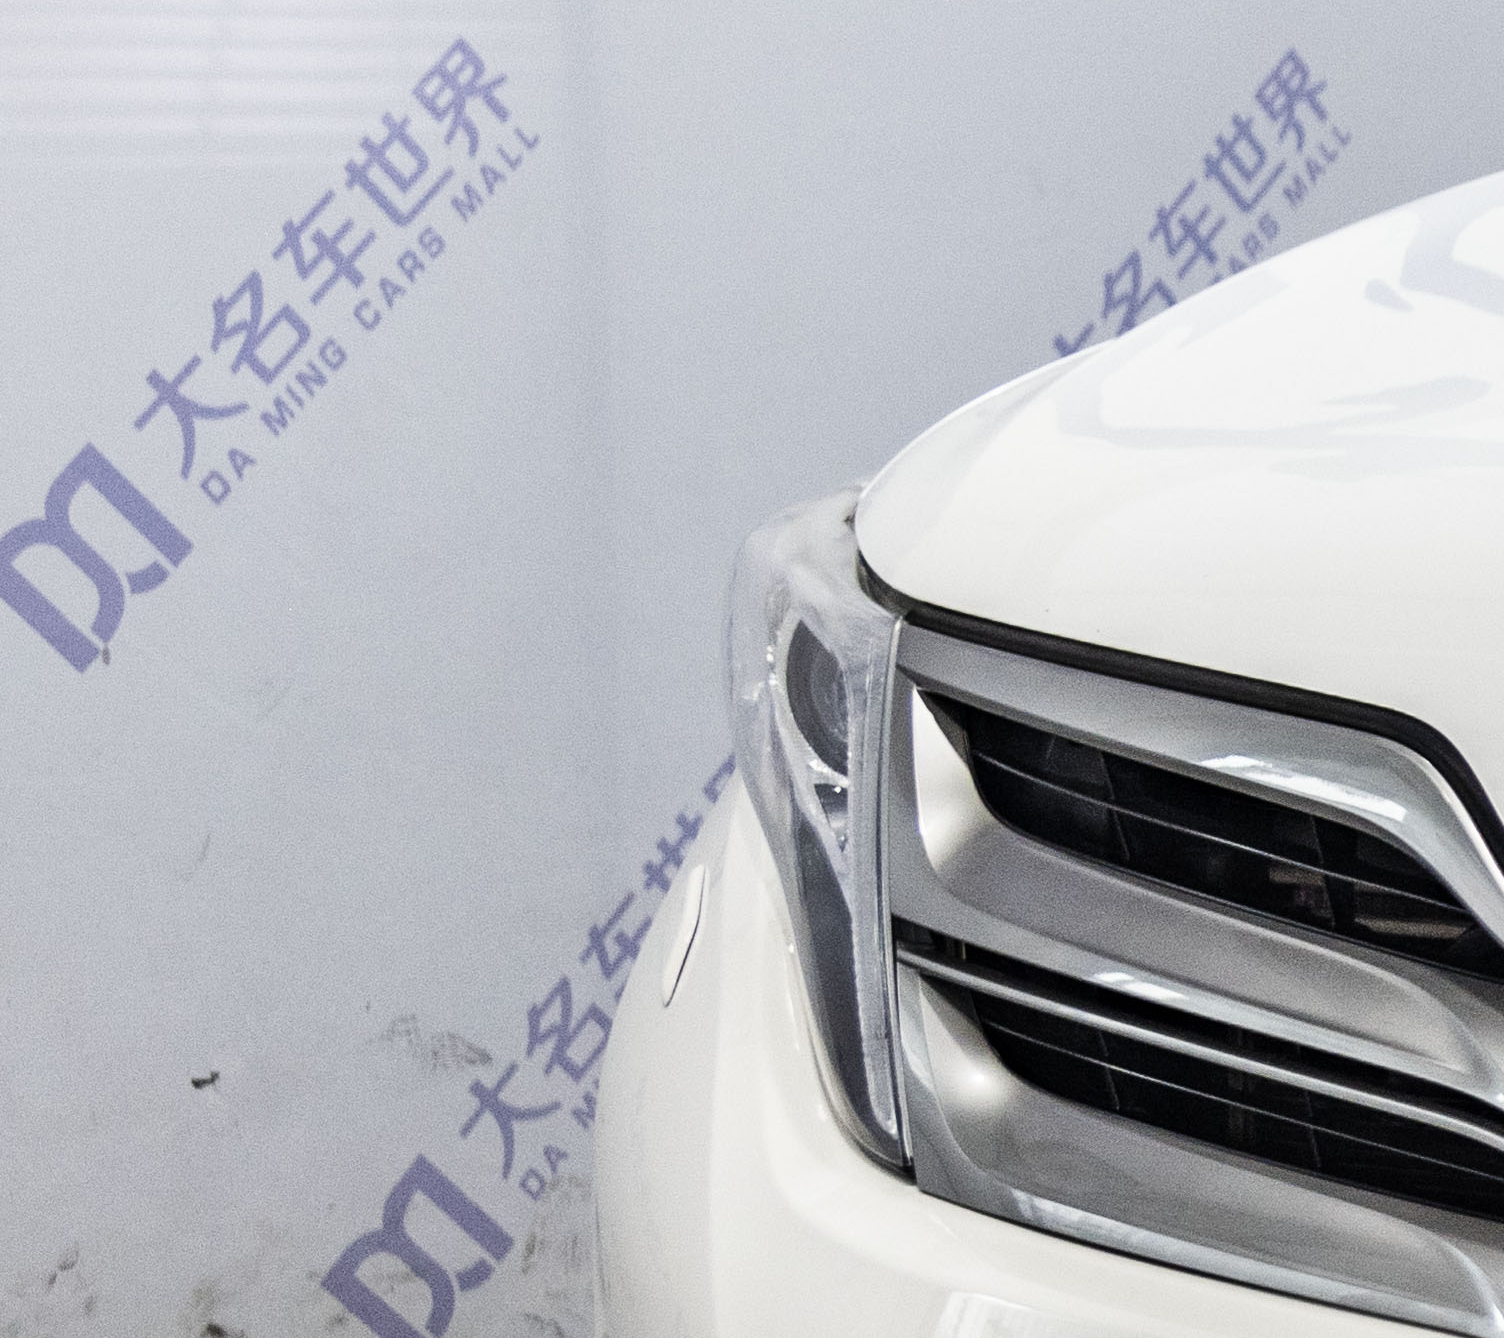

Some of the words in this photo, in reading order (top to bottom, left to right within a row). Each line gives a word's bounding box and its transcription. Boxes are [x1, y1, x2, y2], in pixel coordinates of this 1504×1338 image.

[134, 36, 511, 481] 大名车世界
[199, 445, 257, 507] DA
[259, 336, 348, 437] MING
[352, 226, 446, 332] CARS
[449, 127, 541, 223] MALL
[519, 1145, 568, 1202] DA
